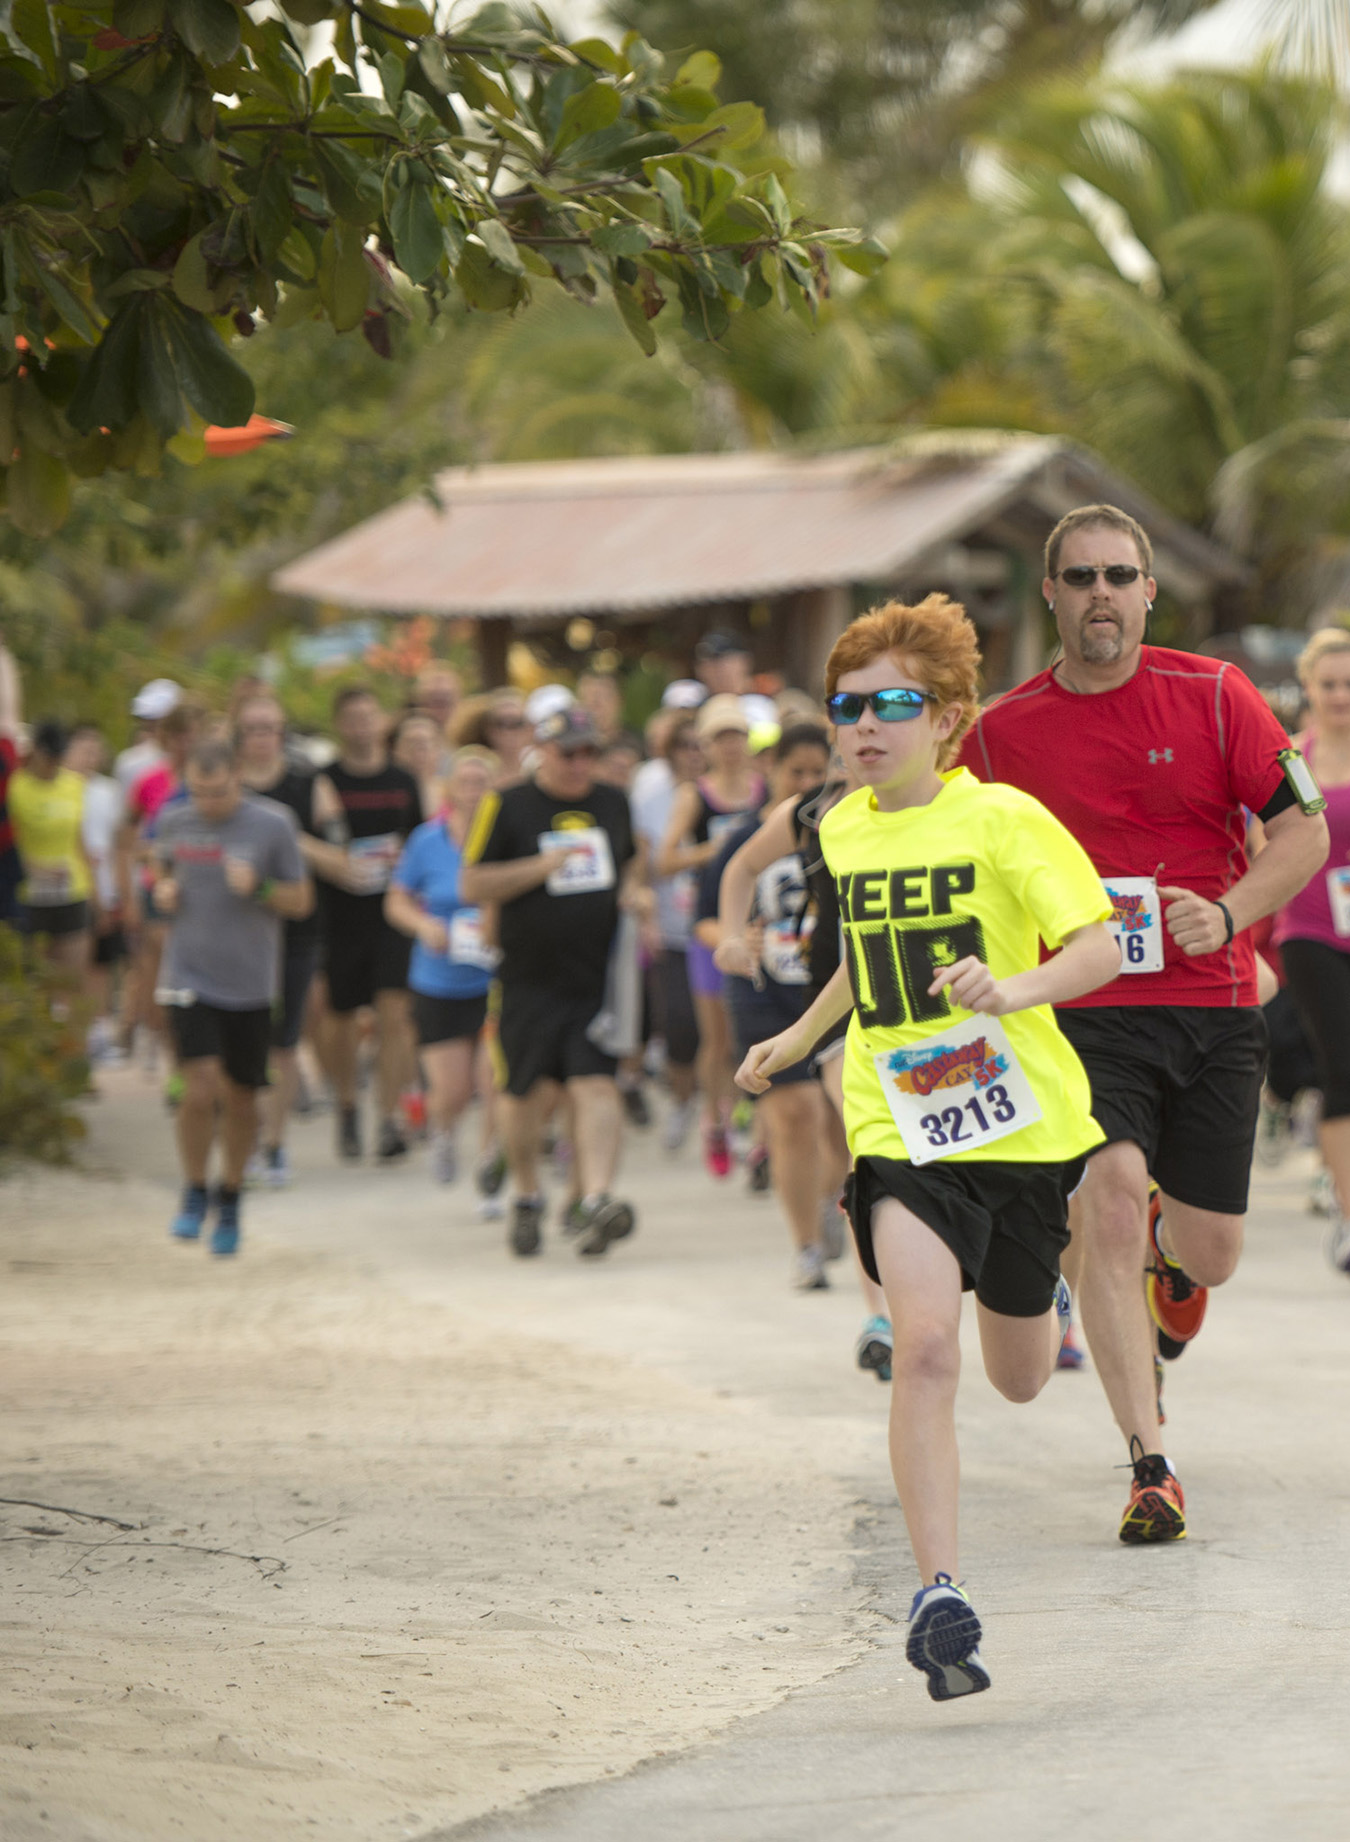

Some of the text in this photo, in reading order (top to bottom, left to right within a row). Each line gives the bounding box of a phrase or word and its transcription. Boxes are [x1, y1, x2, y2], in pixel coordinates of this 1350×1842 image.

[1124, 914, 1147, 931] 5K
[842, 914, 989, 1030] UP
[911, 1036, 987, 1096] Castaway
[945, 1066, 973, 1087] CAY
[974, 1059, 1004, 1087] 5K
[919, 1084, 1017, 1147] 3213
